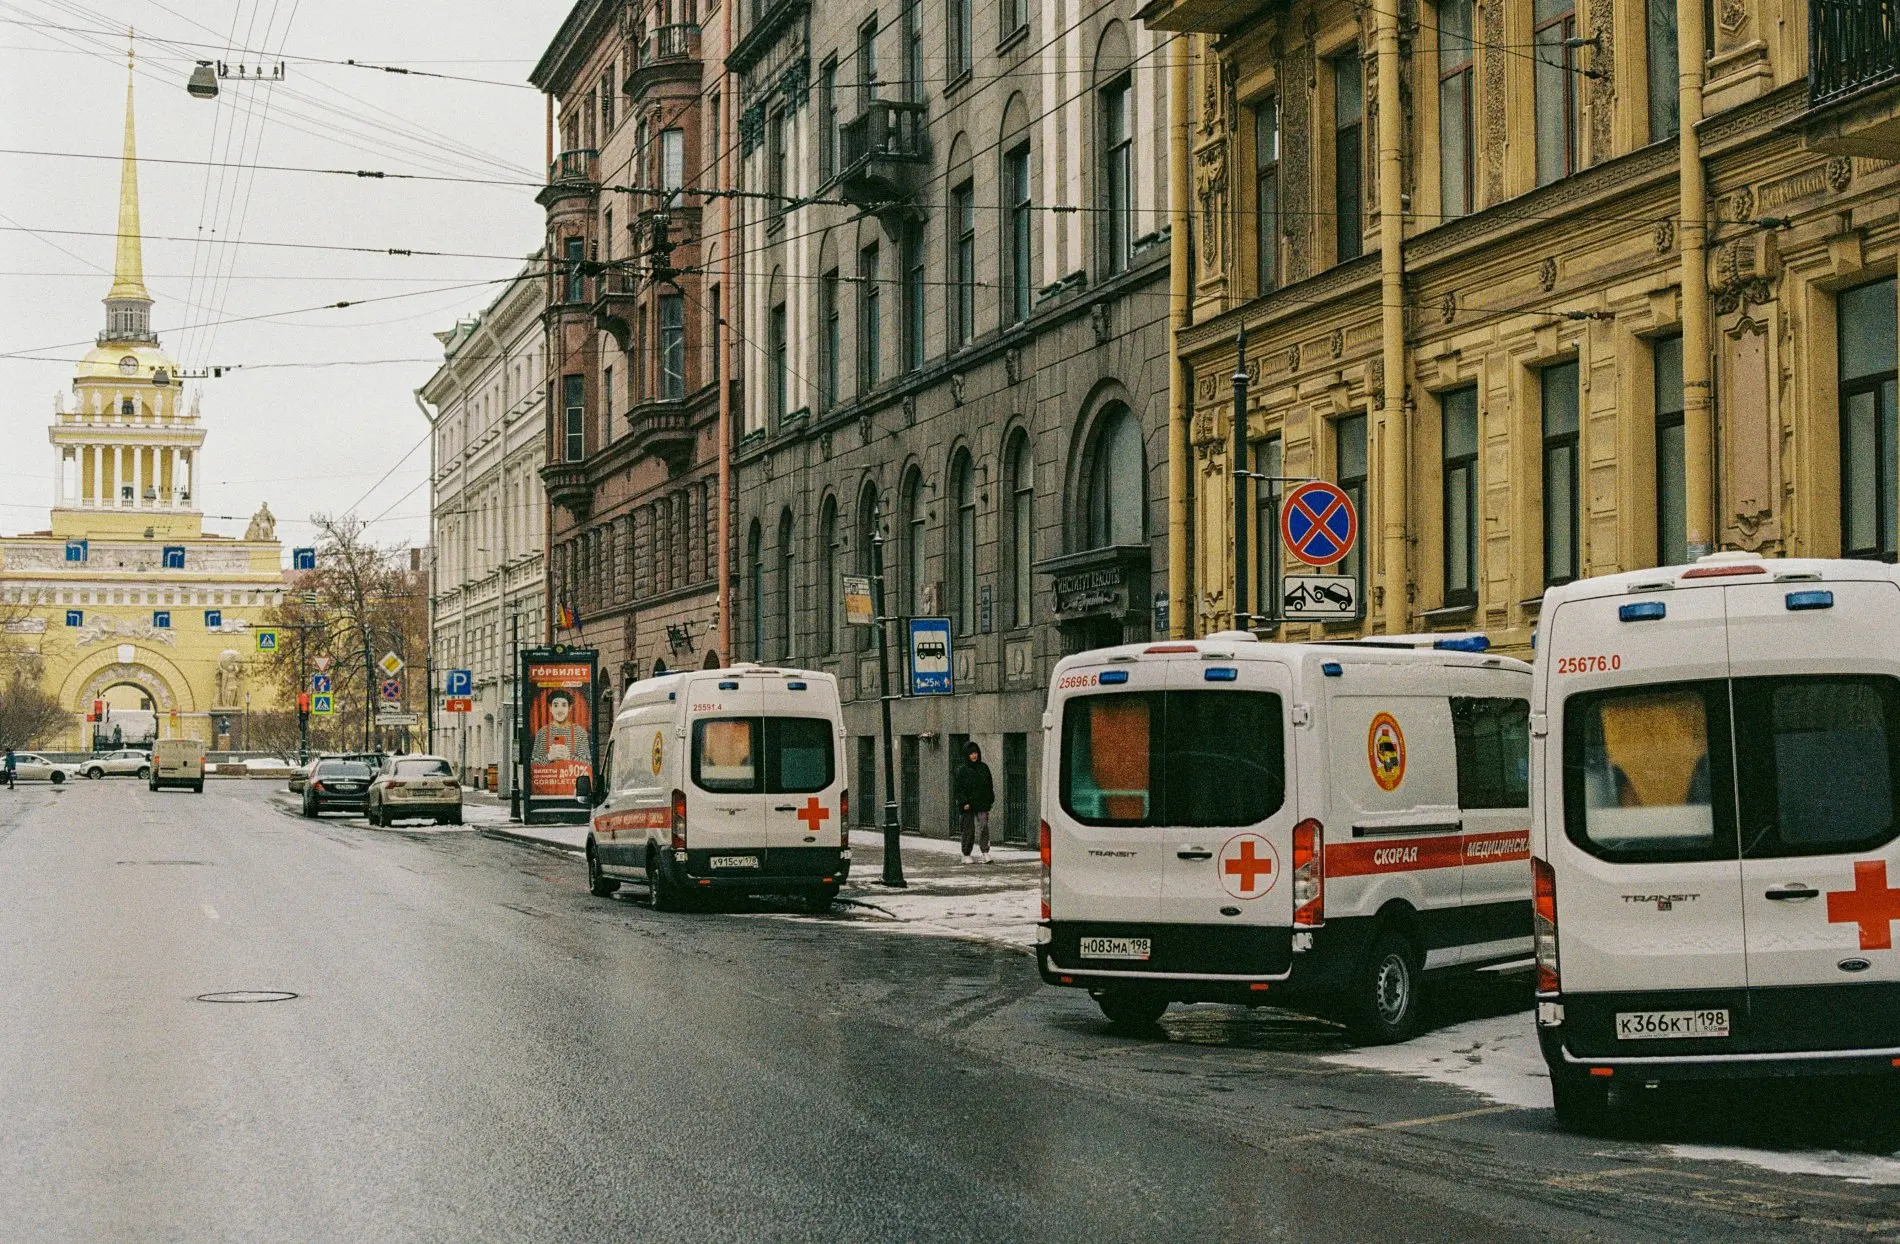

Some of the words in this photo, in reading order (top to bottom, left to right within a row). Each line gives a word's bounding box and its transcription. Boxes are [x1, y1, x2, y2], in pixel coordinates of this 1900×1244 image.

[1059, 573, 1090, 593] ИНСТИТУТ
[532, 666, 588, 676] ГОРБИЛЕТ
[1558, 654, 1621, 674] 25676.0
[453, 673, 467, 693] P
[1059, 675, 1097, 689] 25696.6
[1088, 850, 1138, 858] TRANSIT
[1374, 846, 1418, 865] СКОРАЯ
[1621, 894, 1700, 903] TRANSIT
[1083, 939, 1128, 953] Н083МА
[1130, 939, 1148, 950] 198
[1621, 1014, 1693, 1033] К366КТ
[1697, 1011, 1725, 1026] 198
